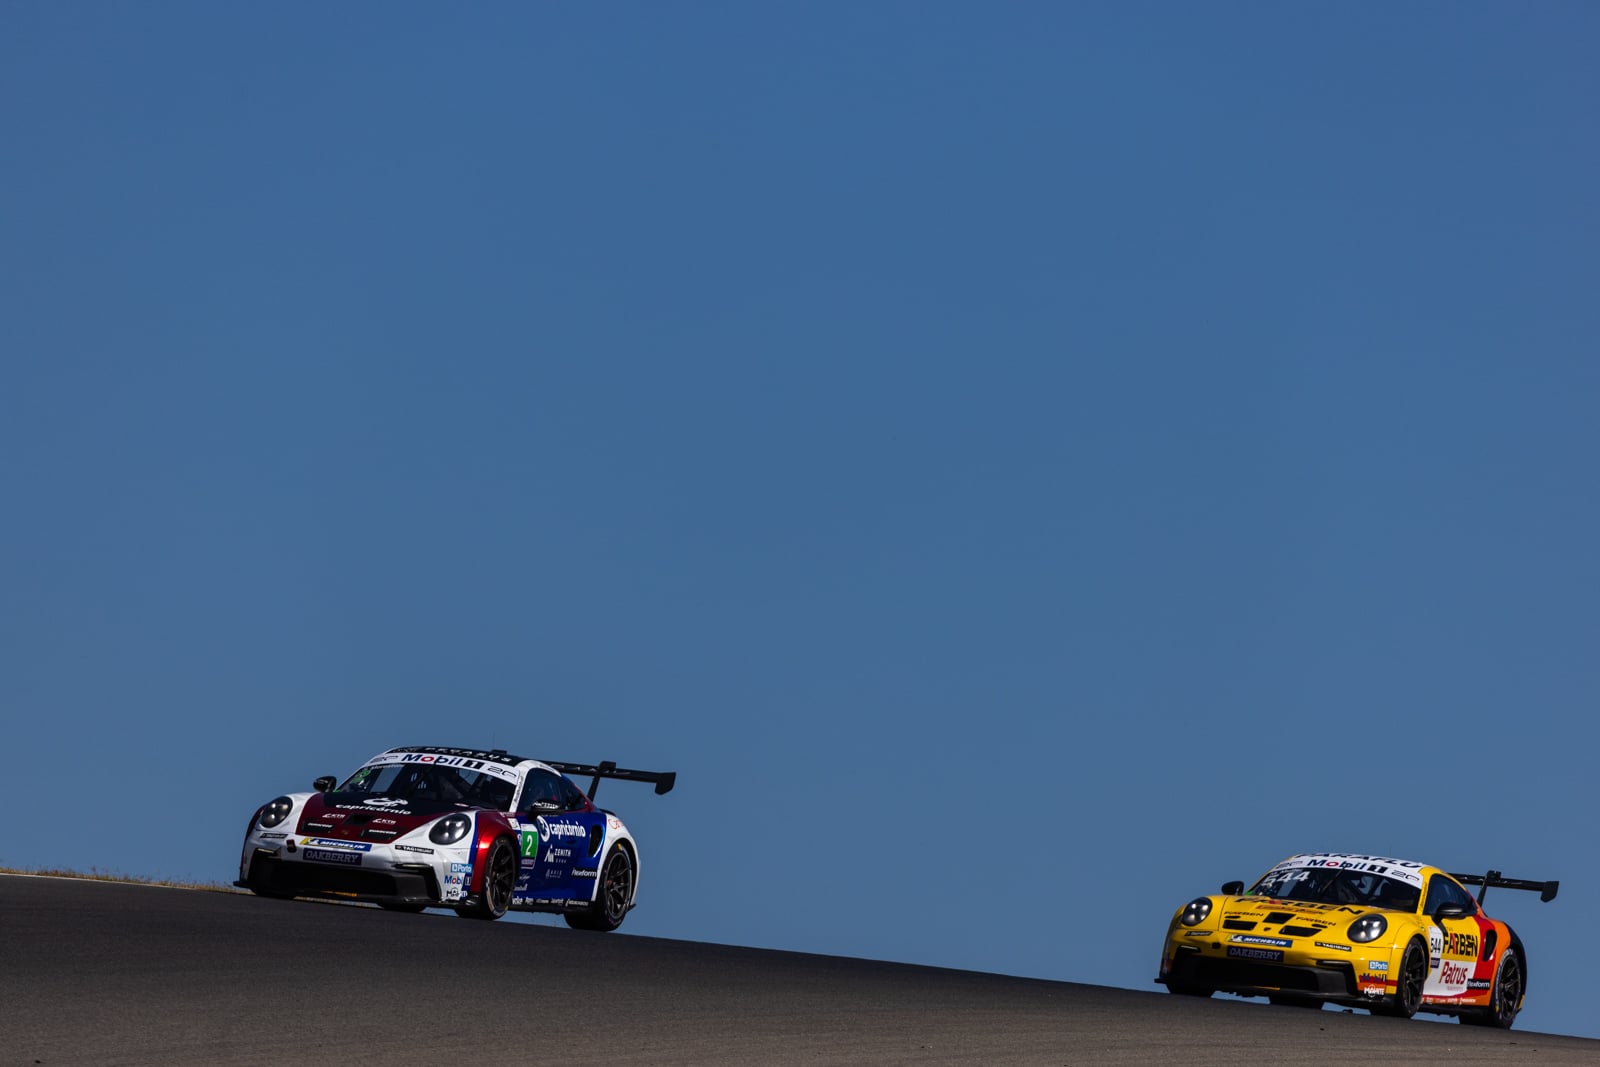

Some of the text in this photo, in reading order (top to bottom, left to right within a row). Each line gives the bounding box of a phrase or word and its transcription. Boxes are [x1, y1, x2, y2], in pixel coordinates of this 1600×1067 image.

[401, 754, 461, 766] Mobil
[336, 804, 411, 815] capricórnio
[320, 840, 366, 849] MICHELIN
[525, 835, 533, 855] 2
[306, 851, 358, 861] OAKBERRY
[554, 849, 571, 857] ZENITH
[458, 864, 472, 872] Porto
[1307, 860, 1367, 870] Mobil
[1261, 871, 1311, 887] 544
[1296, 916, 1336, 926] FARBEN
[1244, 937, 1287, 945] MICHELIN
[1443, 933, 1478, 957] FARBEN
[1229, 947, 1280, 960] OAKBERRY
[1375, 961, 1388, 970] Porto
[1439, 961, 1468, 985] Patrus
